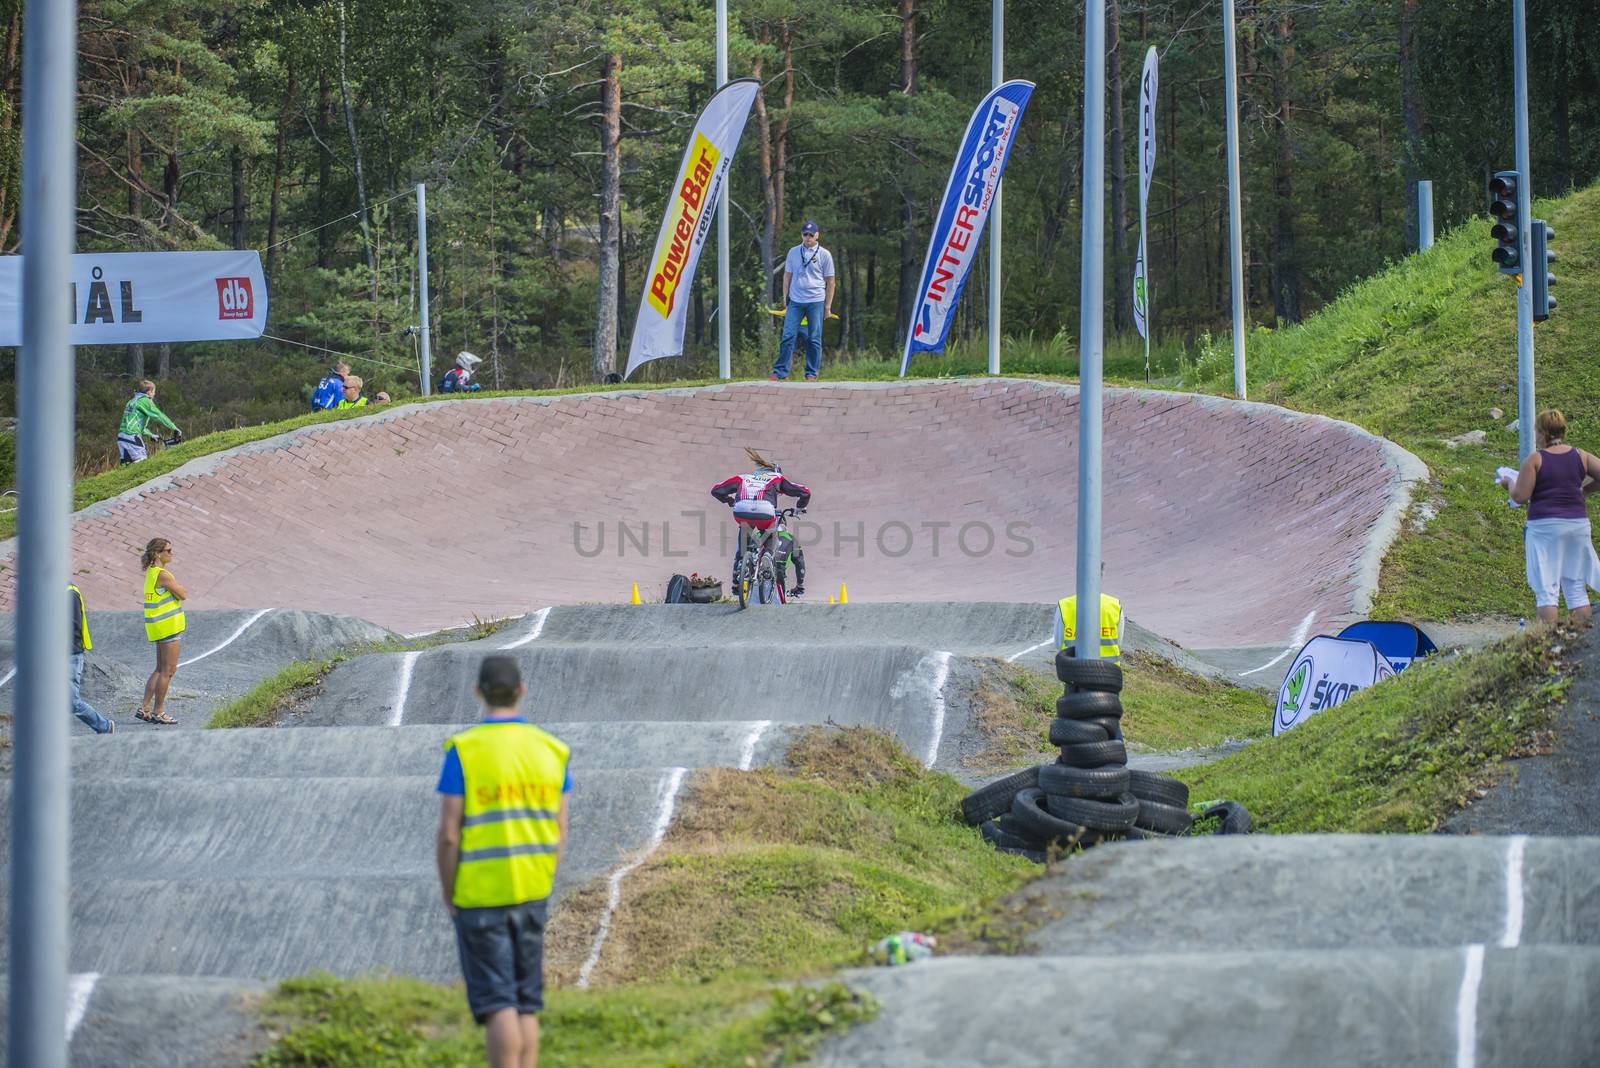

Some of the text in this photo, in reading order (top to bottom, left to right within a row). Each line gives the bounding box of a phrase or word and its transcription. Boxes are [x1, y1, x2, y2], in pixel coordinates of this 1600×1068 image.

[928, 105, 1007, 302] INTERSPORT
[982, 184, 993, 212] SPORT
[990, 166, 997, 178] TO
[995, 145, 1003, 160] THE
[651, 148, 714, 304] PowerBar
[70, 266, 142, 324] ÅL
[223, 280, 248, 310] db
